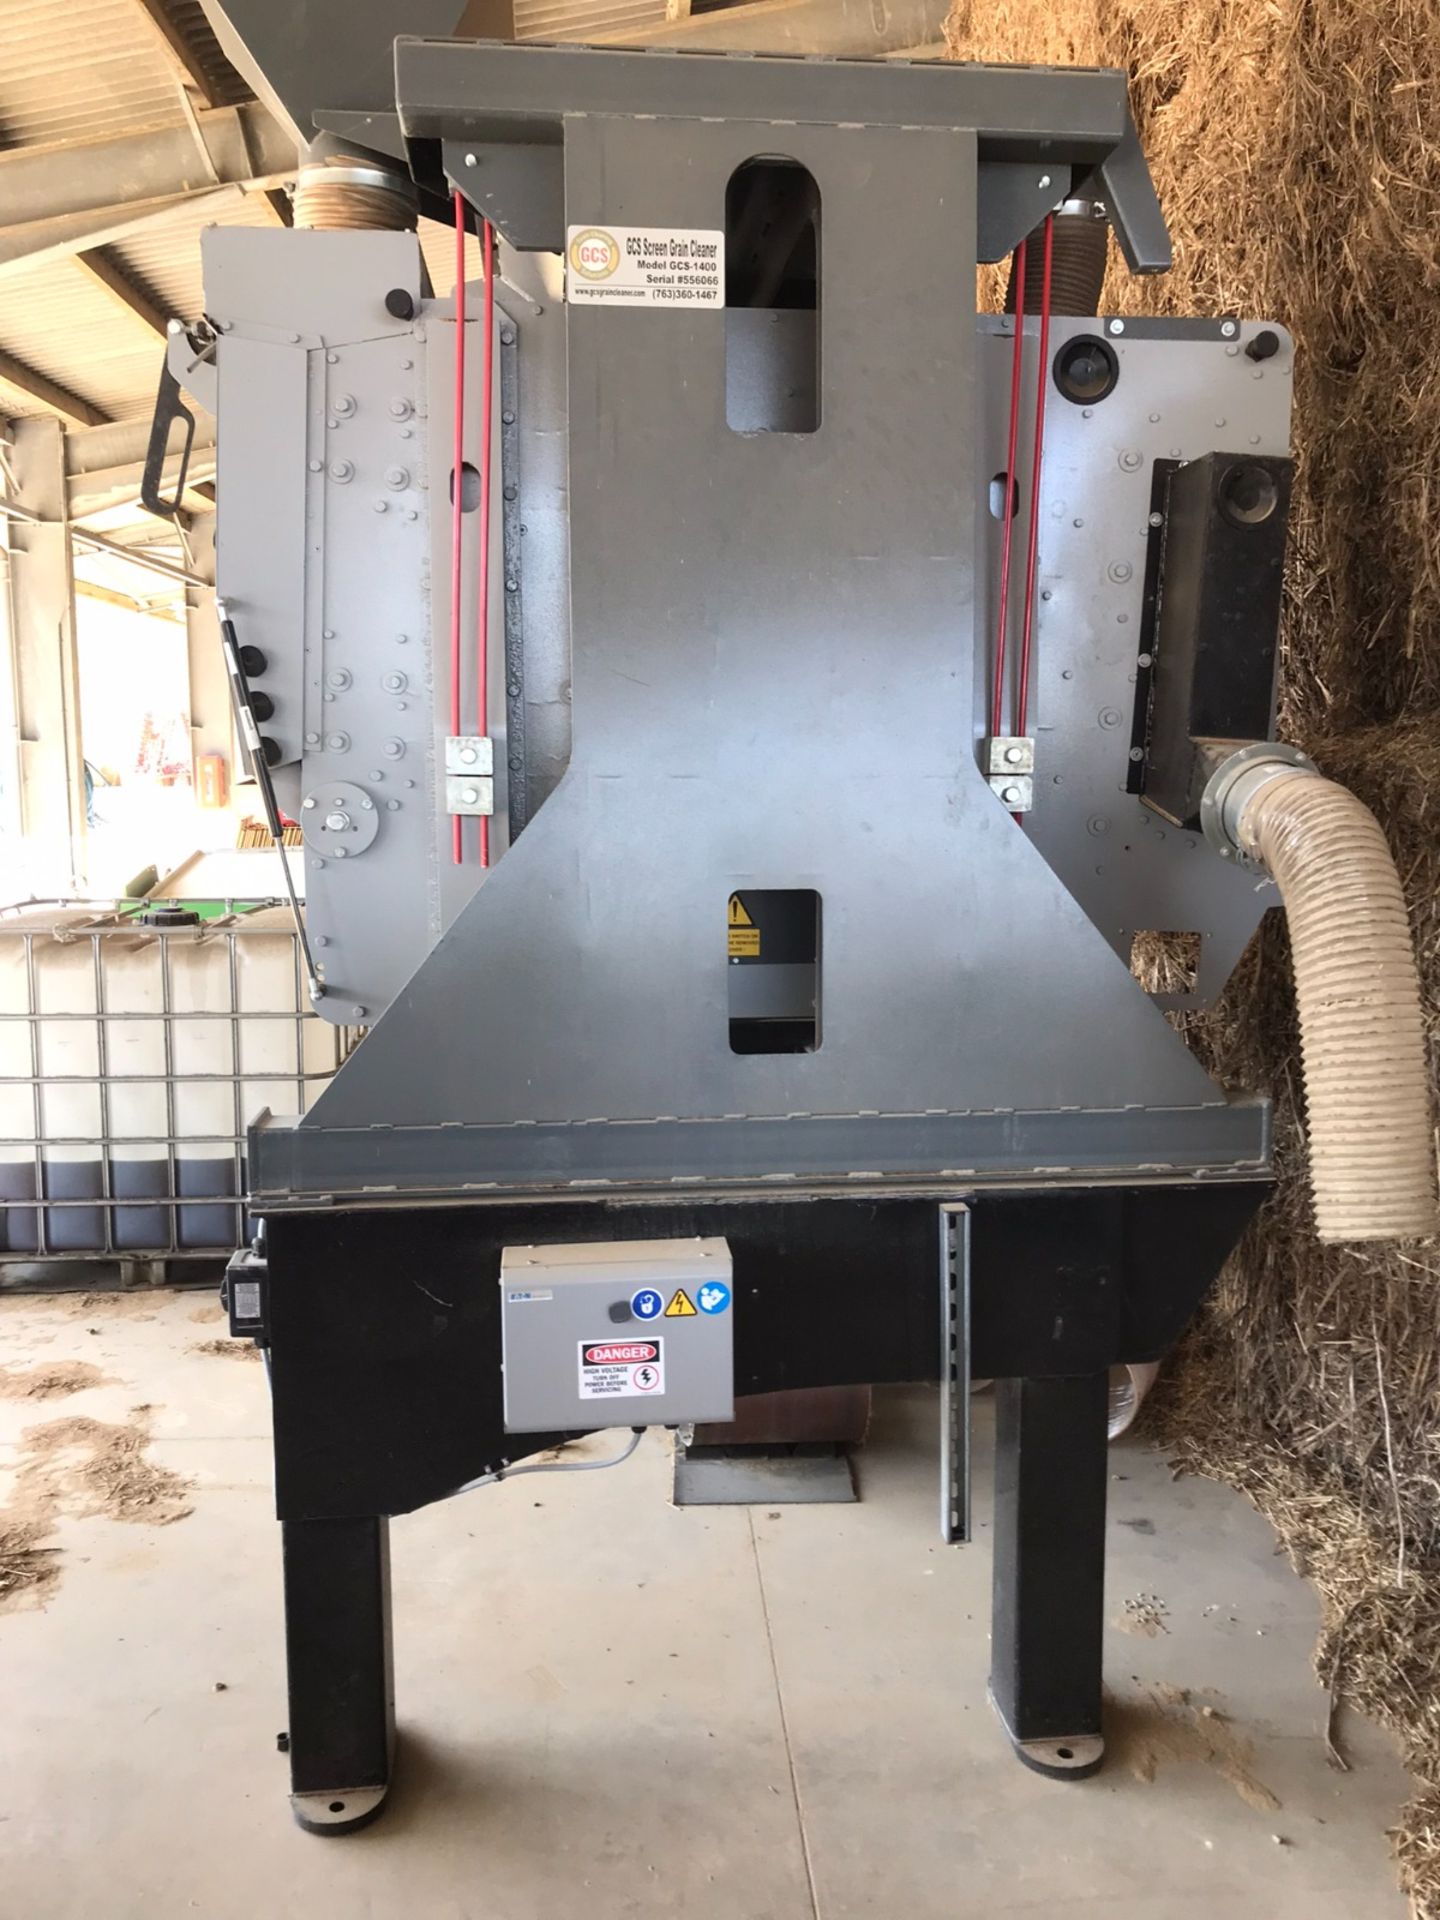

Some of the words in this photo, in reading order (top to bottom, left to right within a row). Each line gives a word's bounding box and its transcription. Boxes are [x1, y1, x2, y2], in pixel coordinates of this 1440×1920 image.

[626, 237, 641, 256] GCS
[643, 237, 668, 257] Screen
[669, 238, 689, 257] Grain
[690, 239, 717, 258] Cleaner
[581, 246, 609, 263] GCS
[637, 260, 667, 270] Model
[669, 261, 717, 271] GCS-1400
[646, 274, 675, 284] Serial
[677, 275, 719, 285] #556066
[652, 289, 718, 300] (763)360-1467
[593, 1347, 650, 1360] DANGER
